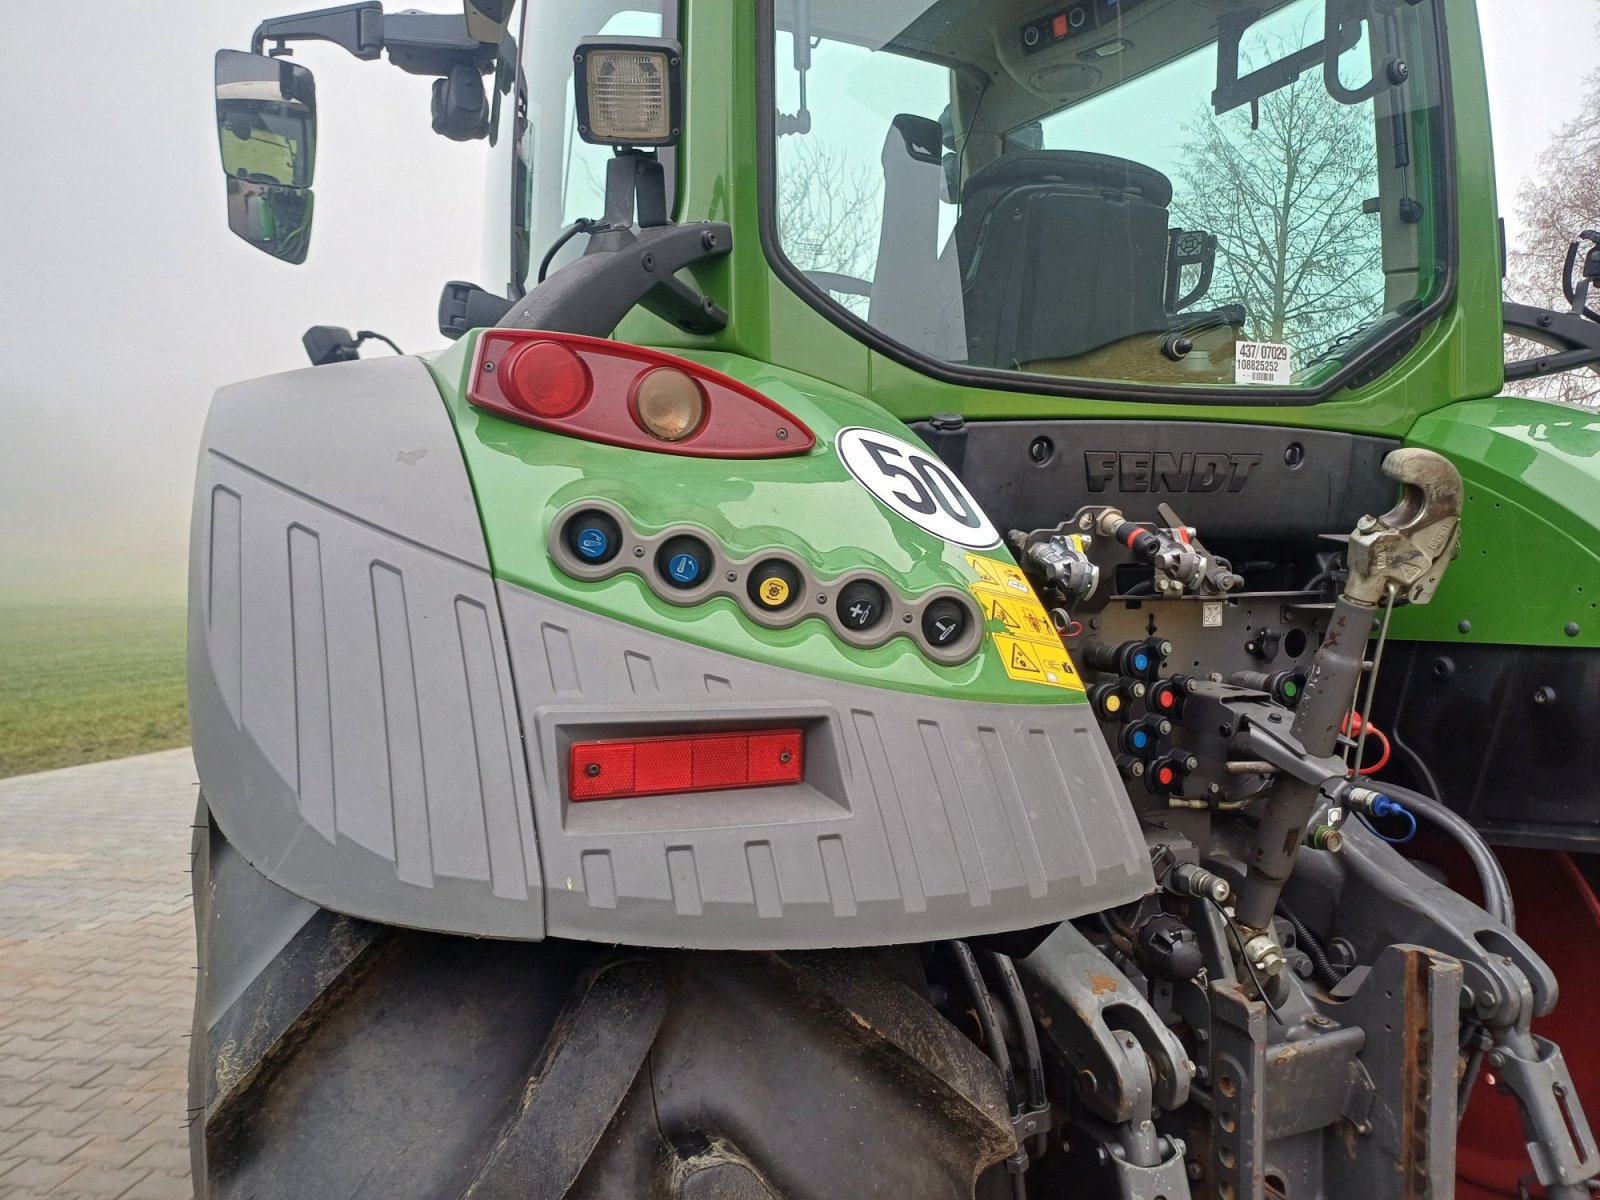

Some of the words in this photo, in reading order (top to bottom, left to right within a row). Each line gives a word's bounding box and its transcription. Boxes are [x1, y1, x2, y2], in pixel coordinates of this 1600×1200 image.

[1237, 359, 1279, 372] 108825252
[858, 437, 982, 529] 50
[1084, 450, 1263, 493] FENDT
